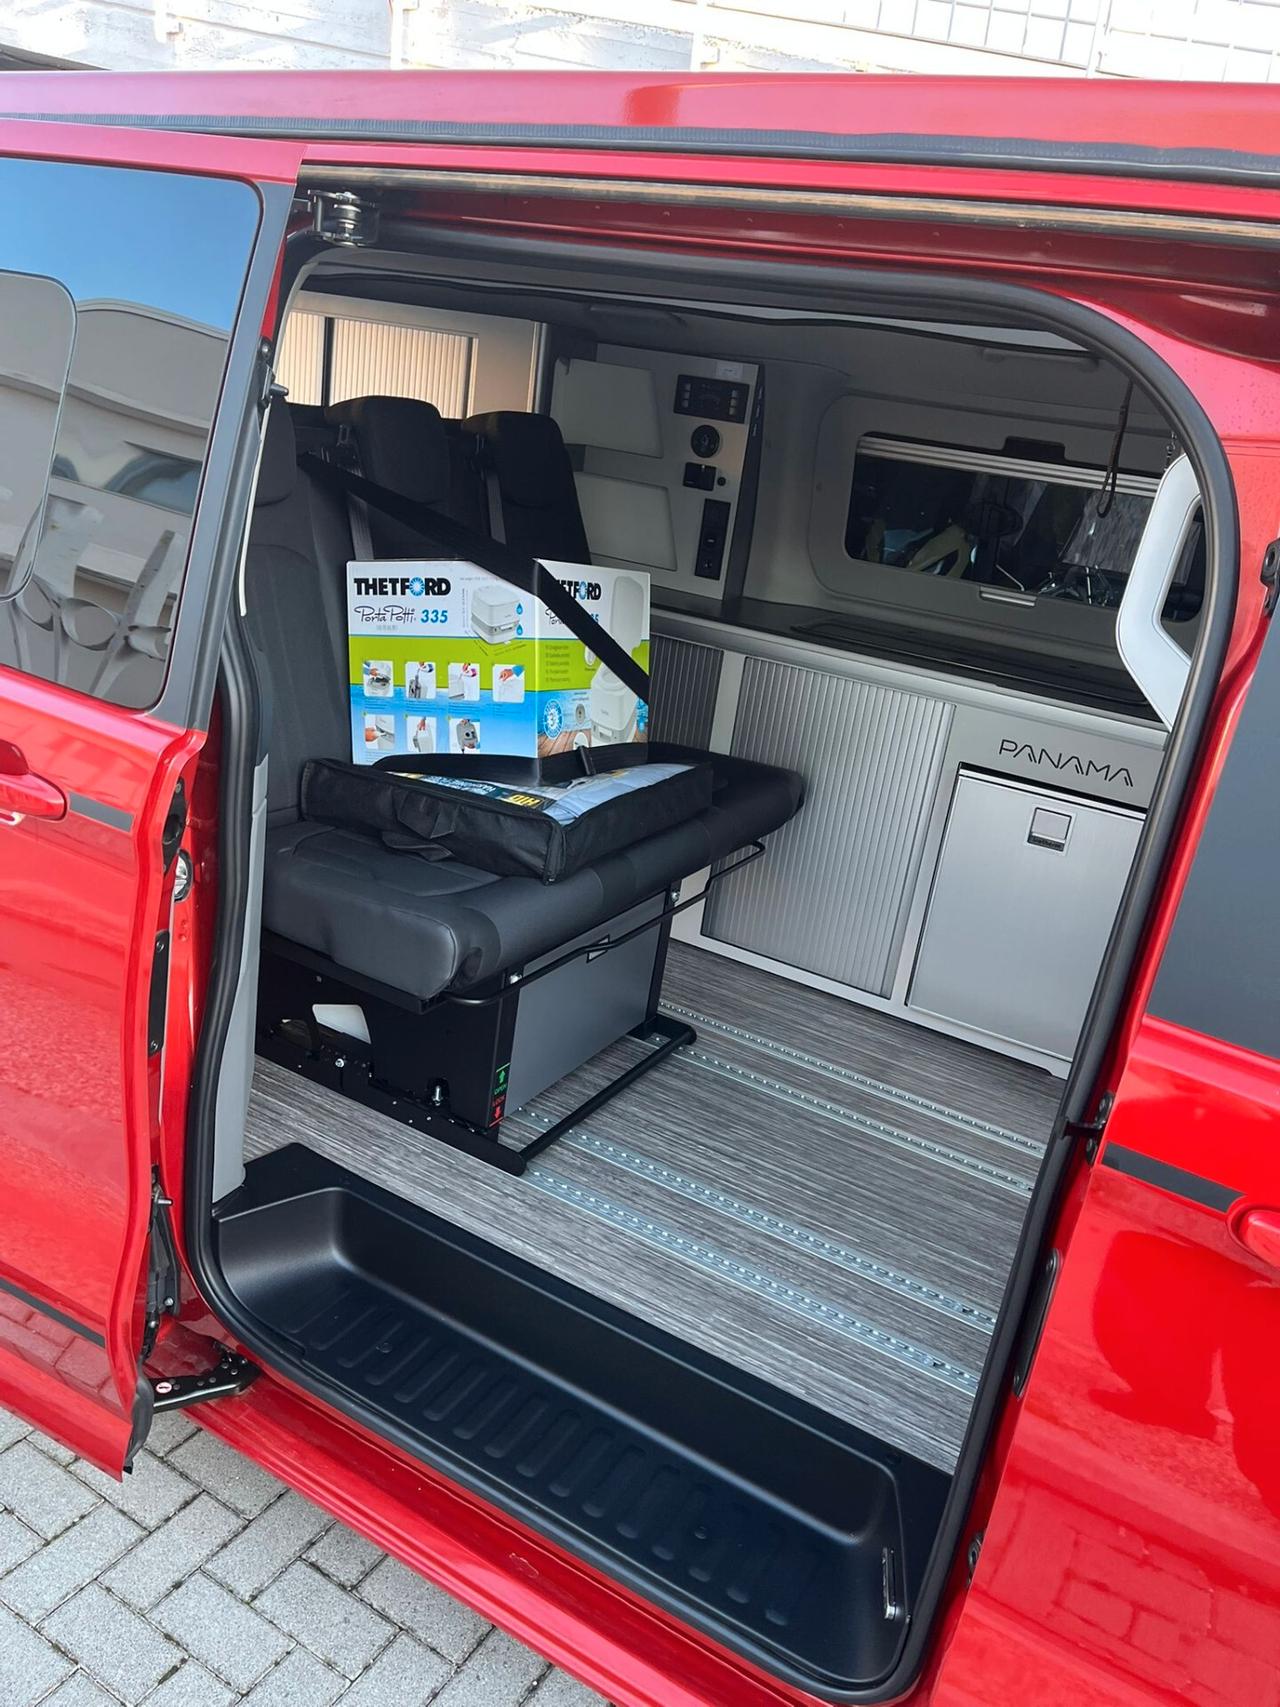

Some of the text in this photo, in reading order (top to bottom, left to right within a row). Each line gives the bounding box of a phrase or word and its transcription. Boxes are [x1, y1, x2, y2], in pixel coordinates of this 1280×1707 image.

[353, 577, 451, 597] THETFORD
[353, 605, 448, 623] Porta Potti 335
[999, 739, 1134, 787] PANAMA
